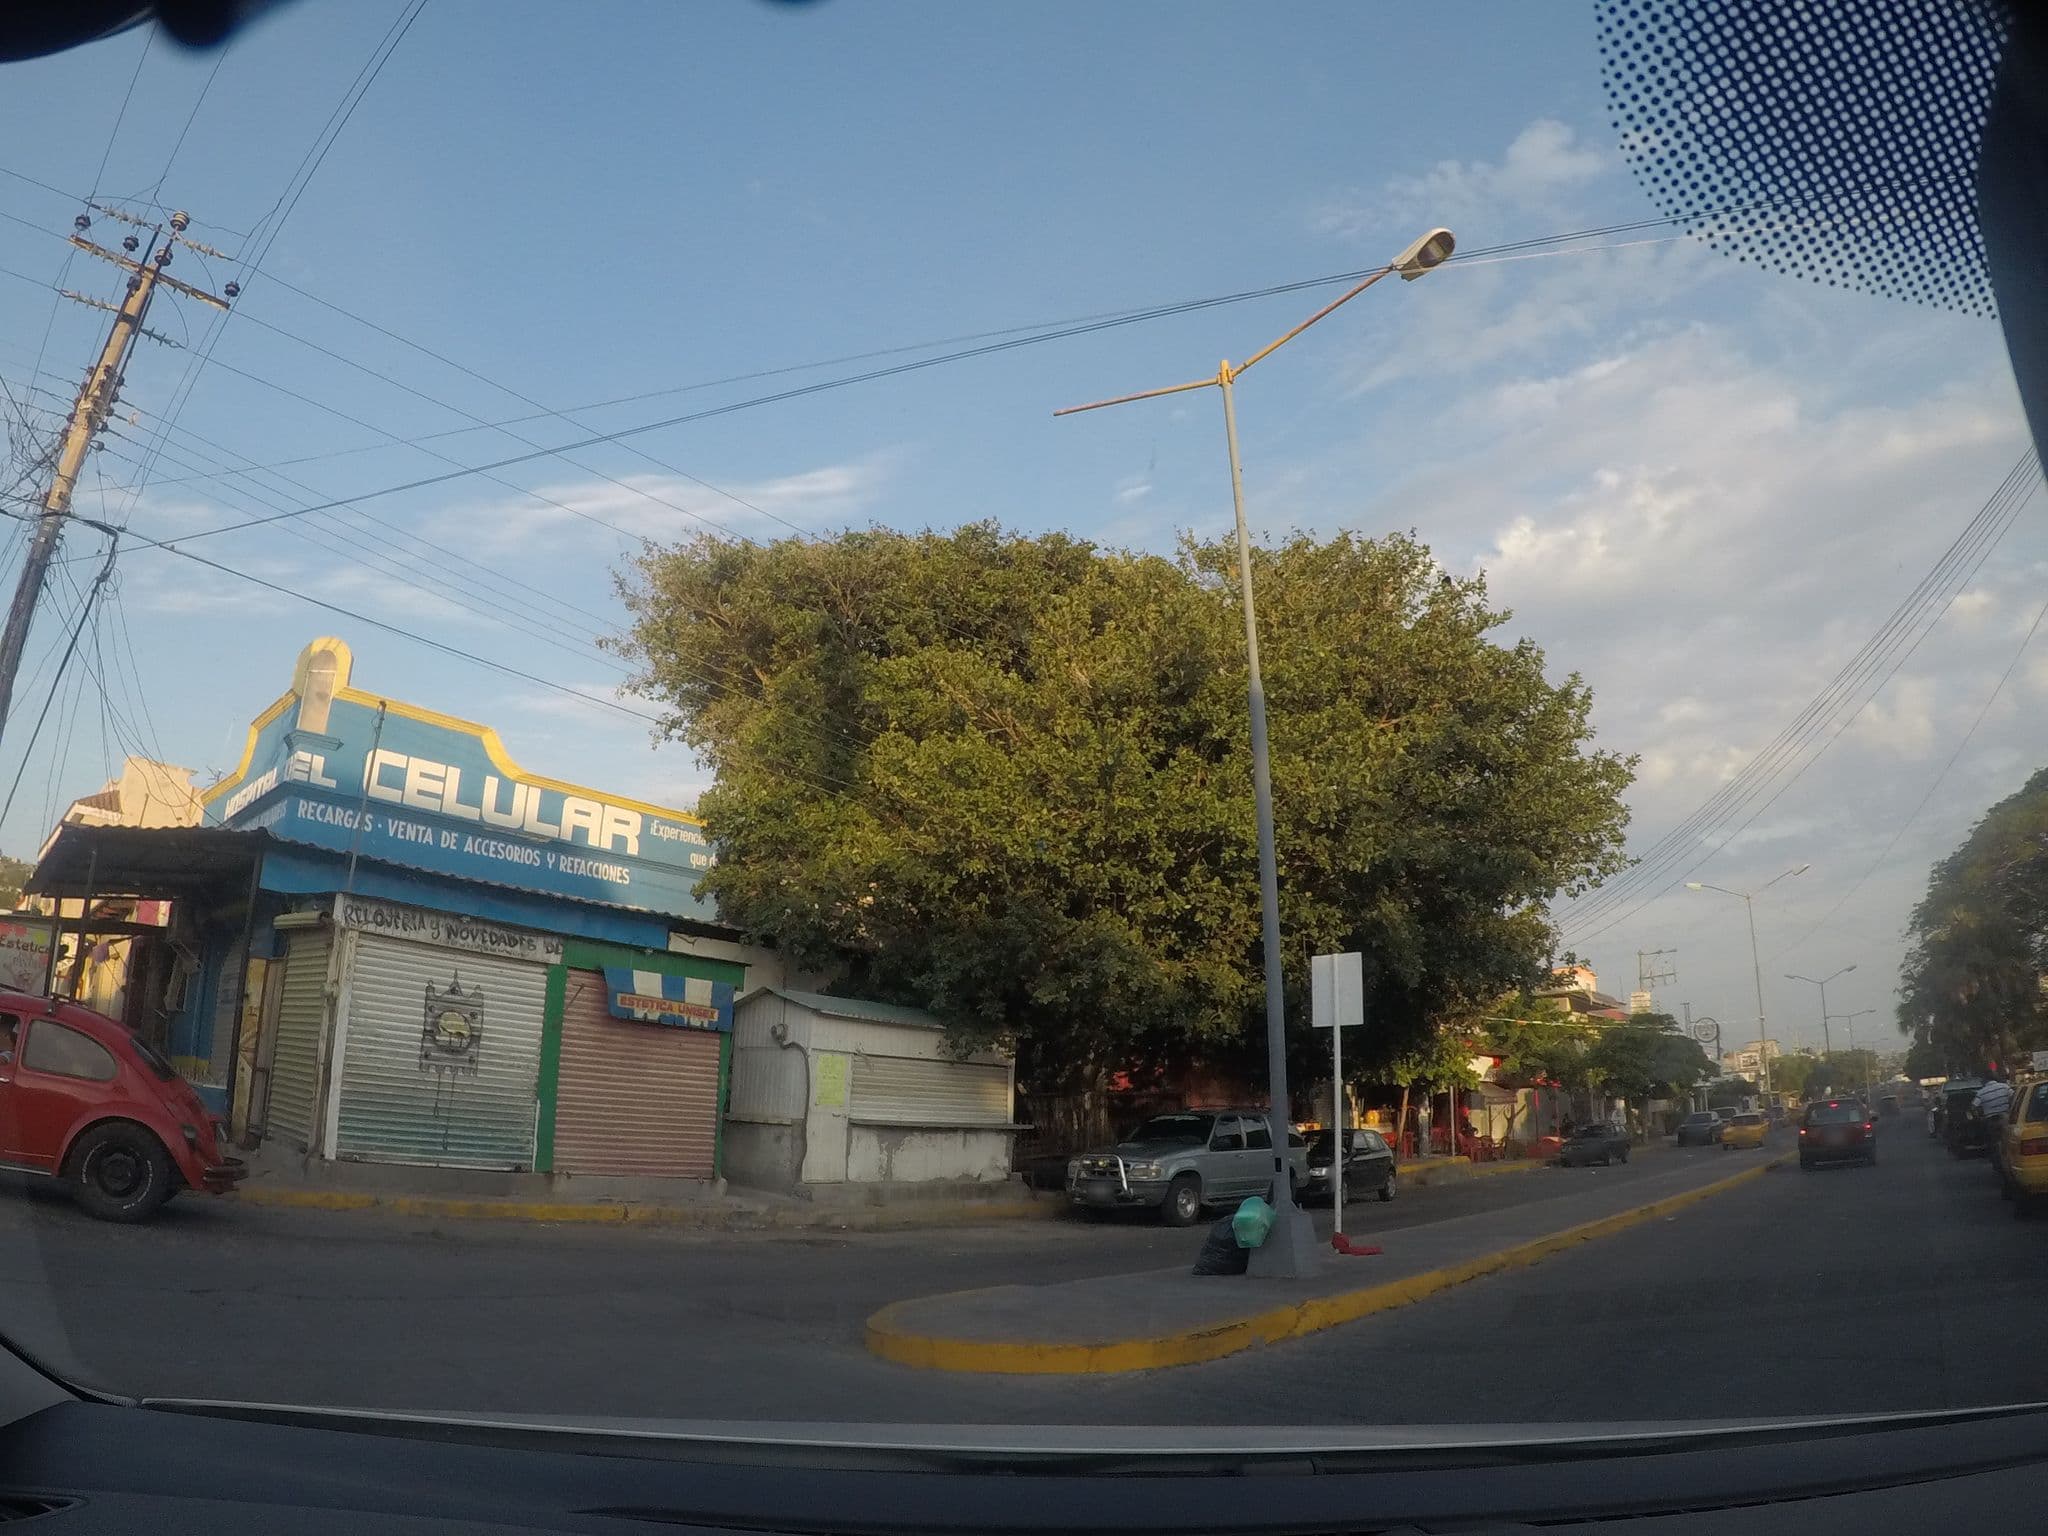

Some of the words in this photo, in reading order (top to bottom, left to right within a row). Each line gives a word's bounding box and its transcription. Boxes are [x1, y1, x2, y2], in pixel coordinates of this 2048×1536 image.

[297, 800, 374, 832] RECARGAS
[388, 818, 433, 846] VENTA
[440, 830, 459, 850] DE
[463, 836, 541, 867] ACCESORIOS
[546, 852, 556, 869] Y
[559, 855, 630, 885] REFACCIONES
[363, 749, 641, 855] CELULAR
[620, 995, 674, 1013] ESTETICA
